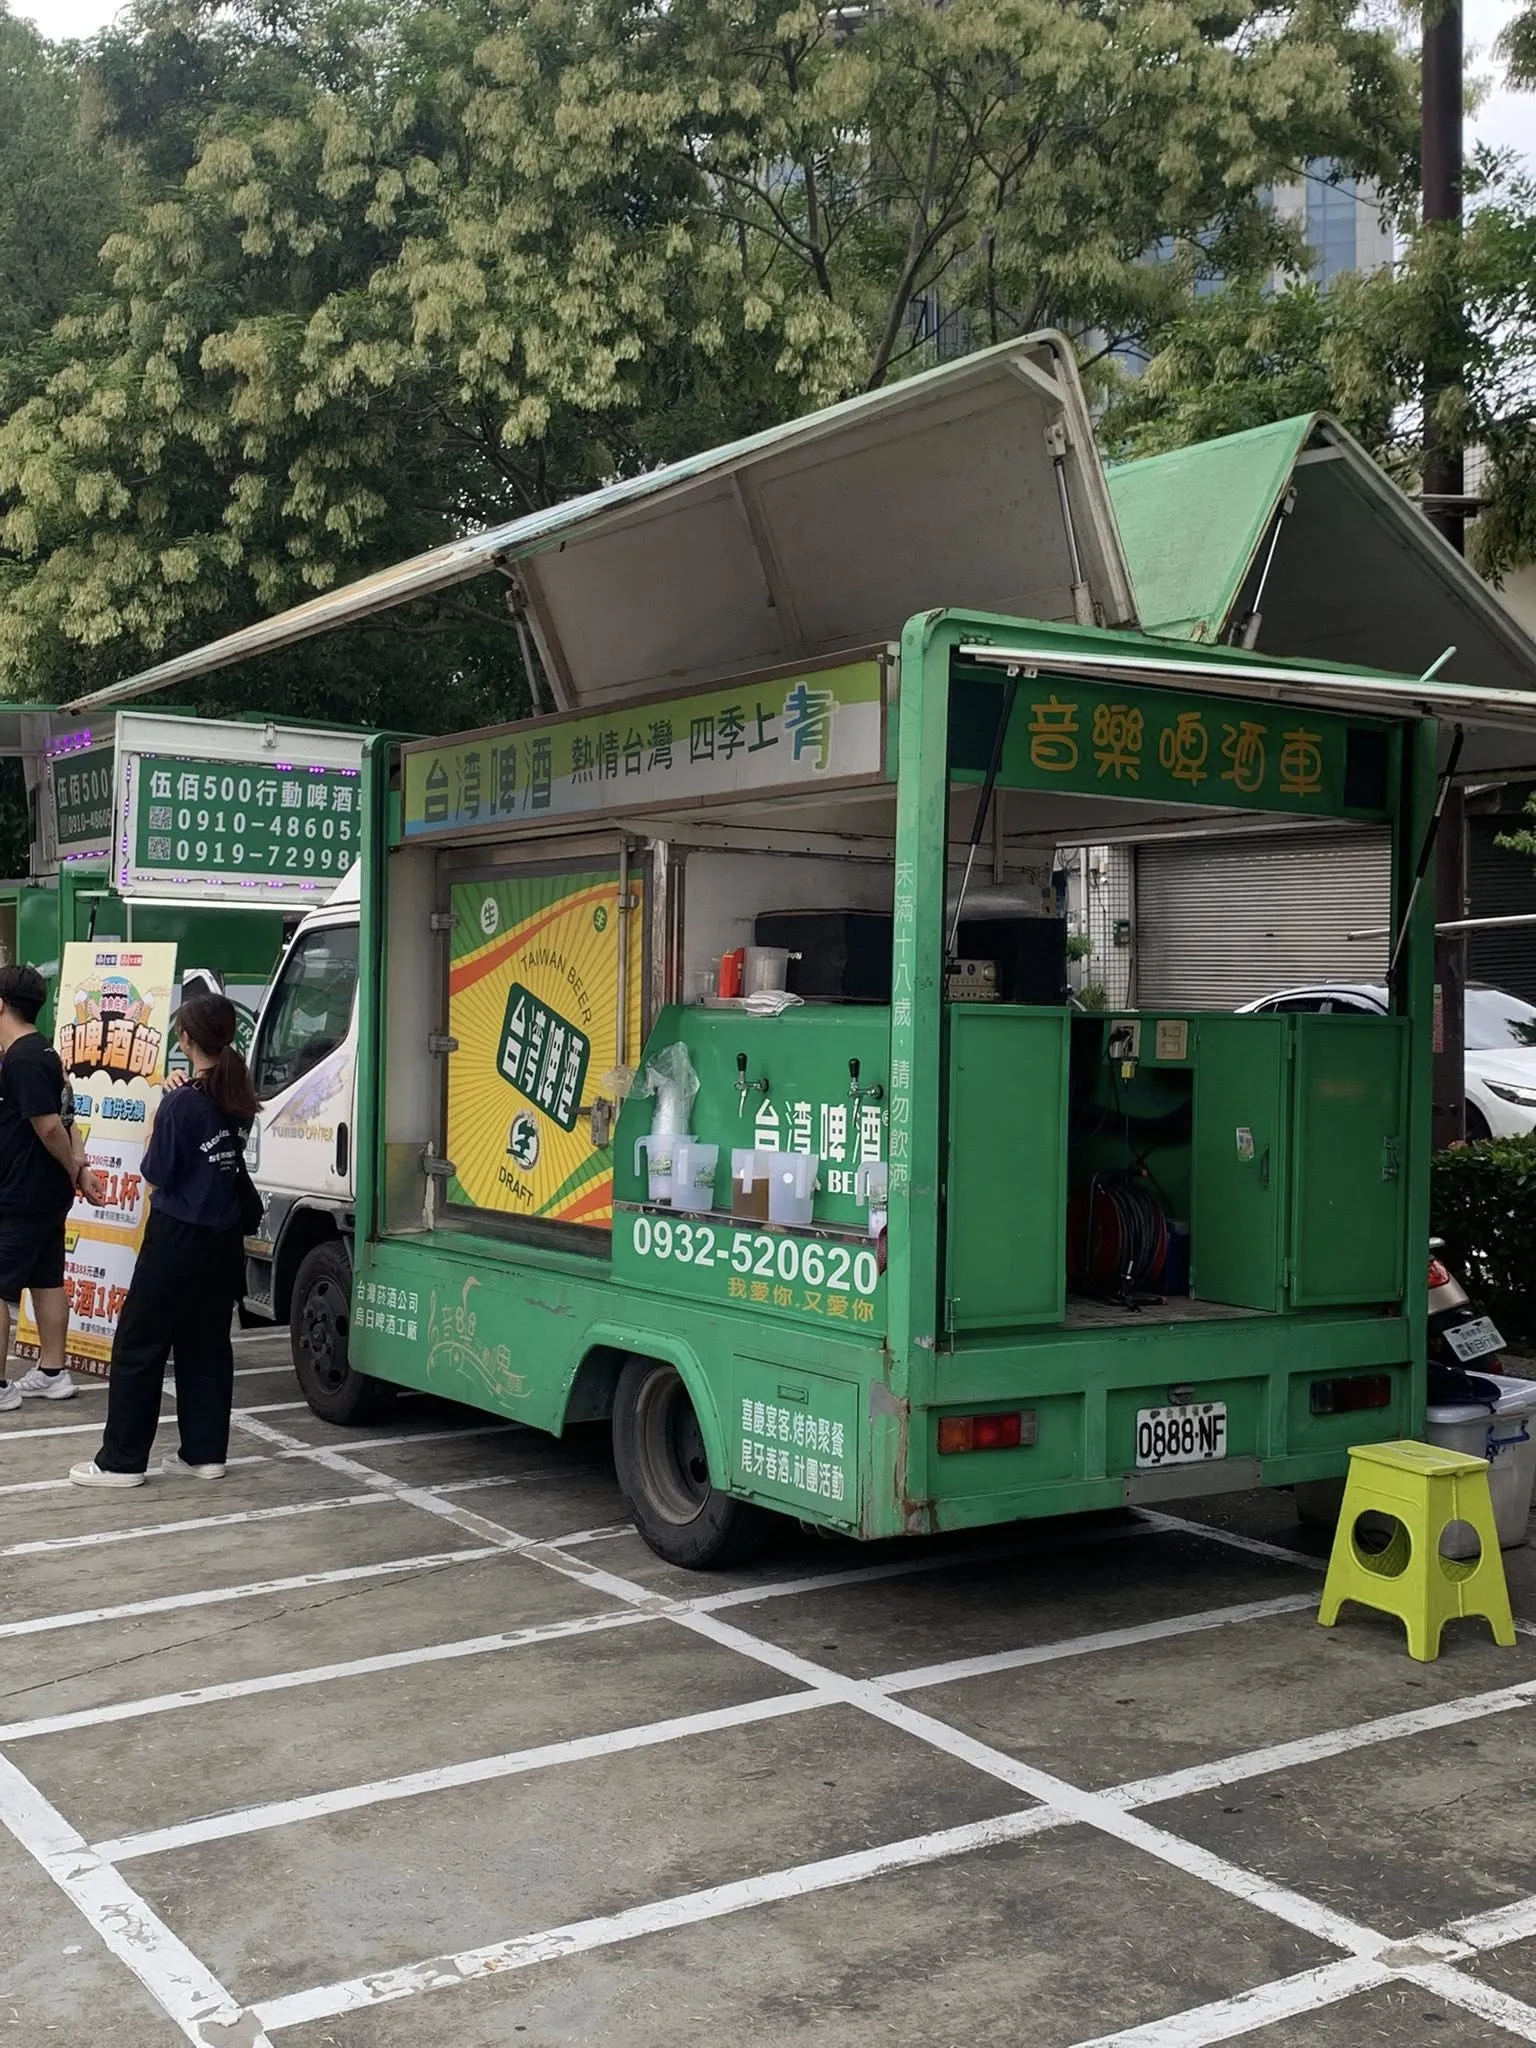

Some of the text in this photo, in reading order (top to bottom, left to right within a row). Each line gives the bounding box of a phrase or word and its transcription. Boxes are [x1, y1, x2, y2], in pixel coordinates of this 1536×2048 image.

[571, 719, 673, 785] 熱情台灣
[1028, 694, 1323, 798] 音樂啤酒車
[57, 767, 114, 809] 伍佰500
[149, 770, 361, 813] 伍佰500行動啤酒
[178, 808, 361, 841] 0910-48605
[176, 840, 361, 871] 0919-72998
[483, 904, 497, 928] 生
[520, 948, 592, 1026] TAIWAN BEER
[499, 1166, 535, 1208] DRAFT
[632, 1217, 879, 1296] 0932-520620
[356, 1279, 419, 1314] 台灣菸酒公司
[354, 1307, 418, 1342] 烏日啤酒工廠
